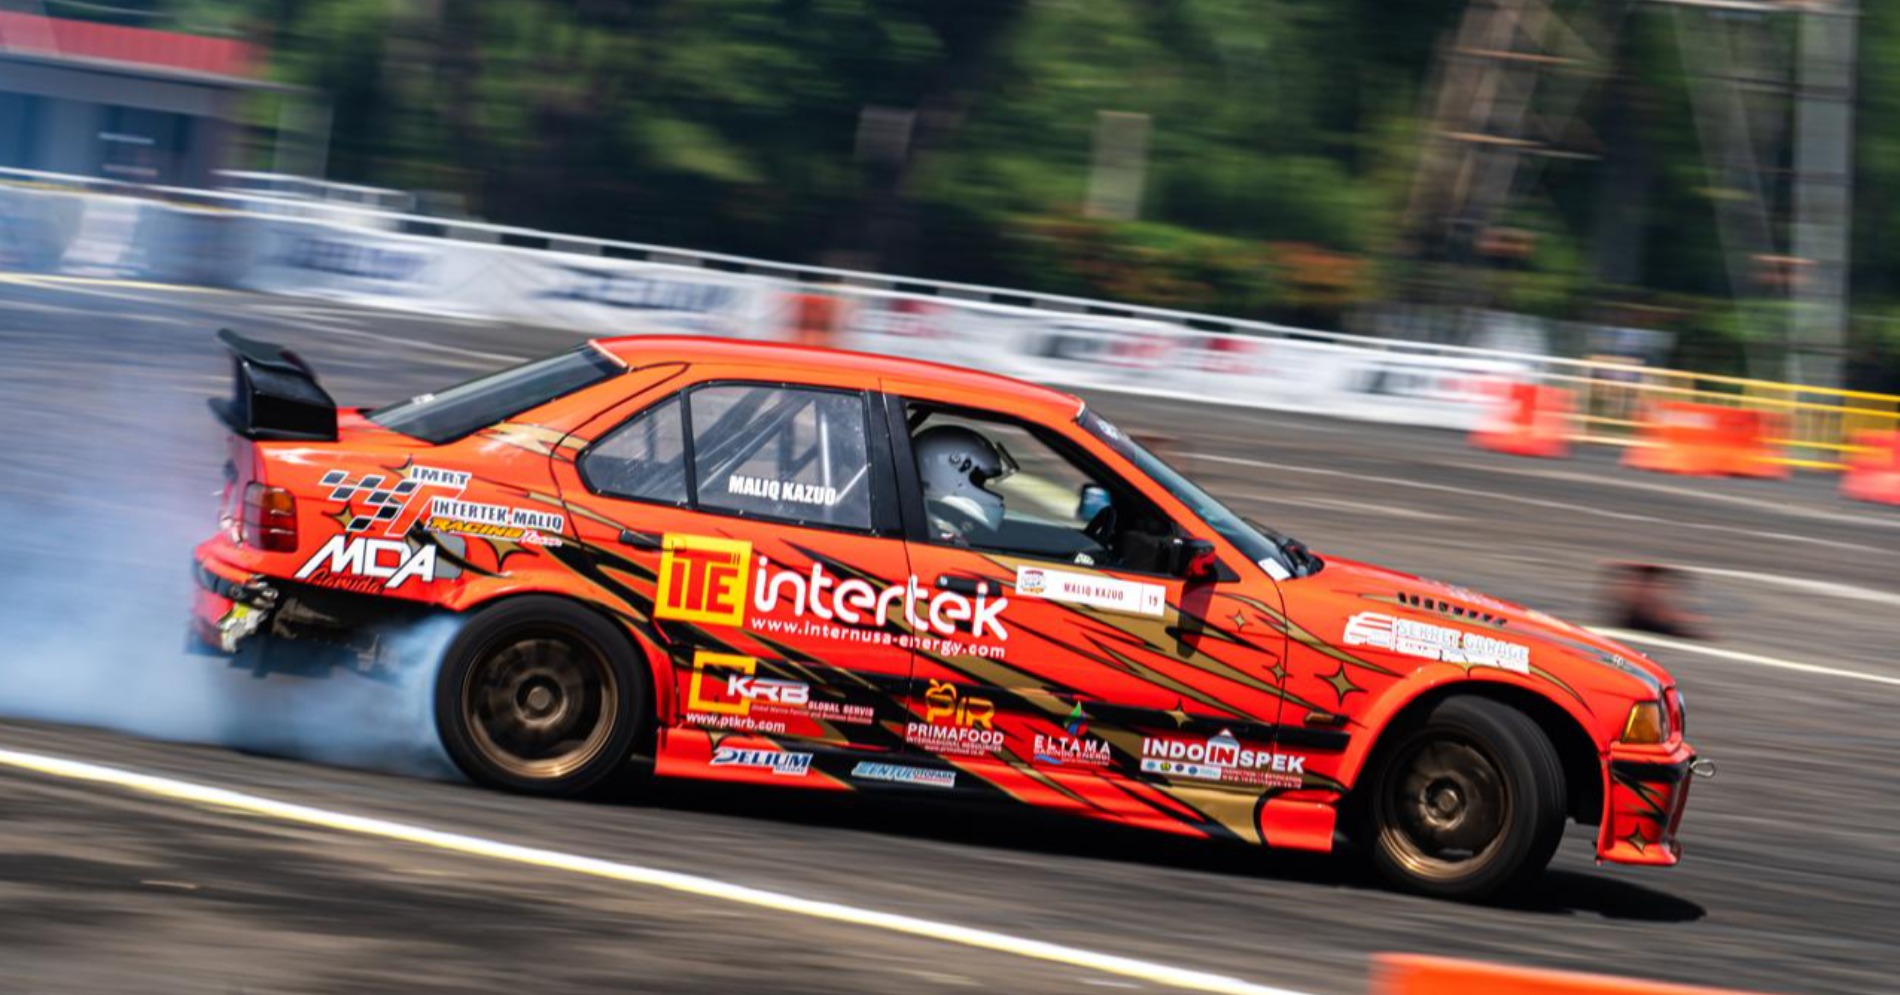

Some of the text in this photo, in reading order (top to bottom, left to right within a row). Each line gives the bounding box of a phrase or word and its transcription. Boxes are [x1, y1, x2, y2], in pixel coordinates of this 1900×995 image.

[411, 467, 469, 485] IMRT
[728, 475, 836, 506] MALIQ KAZUO
[429, 517, 526, 539] RACING
[294, 534, 436, 588] MDA
[754, 555, 1008, 640] intertek
[1063, 581, 1092, 597] MALIQ
[1095, 587, 1124, 601] KAZUO
[751, 618, 1005, 659] www.internusa-energy.com
[1464, 633, 1527, 660] GARAGE
[727, 674, 809, 704] KRB
[808, 701, 840, 713] GLOBAL
[926, 679, 995, 729] PIR
[686, 712, 785, 733] www.ptkrb.com
[907, 722, 1004, 745] PRIMAFOOD
[1034, 734, 1111, 755] ELTAMA
[711, 748, 812, 769] DELIUM
